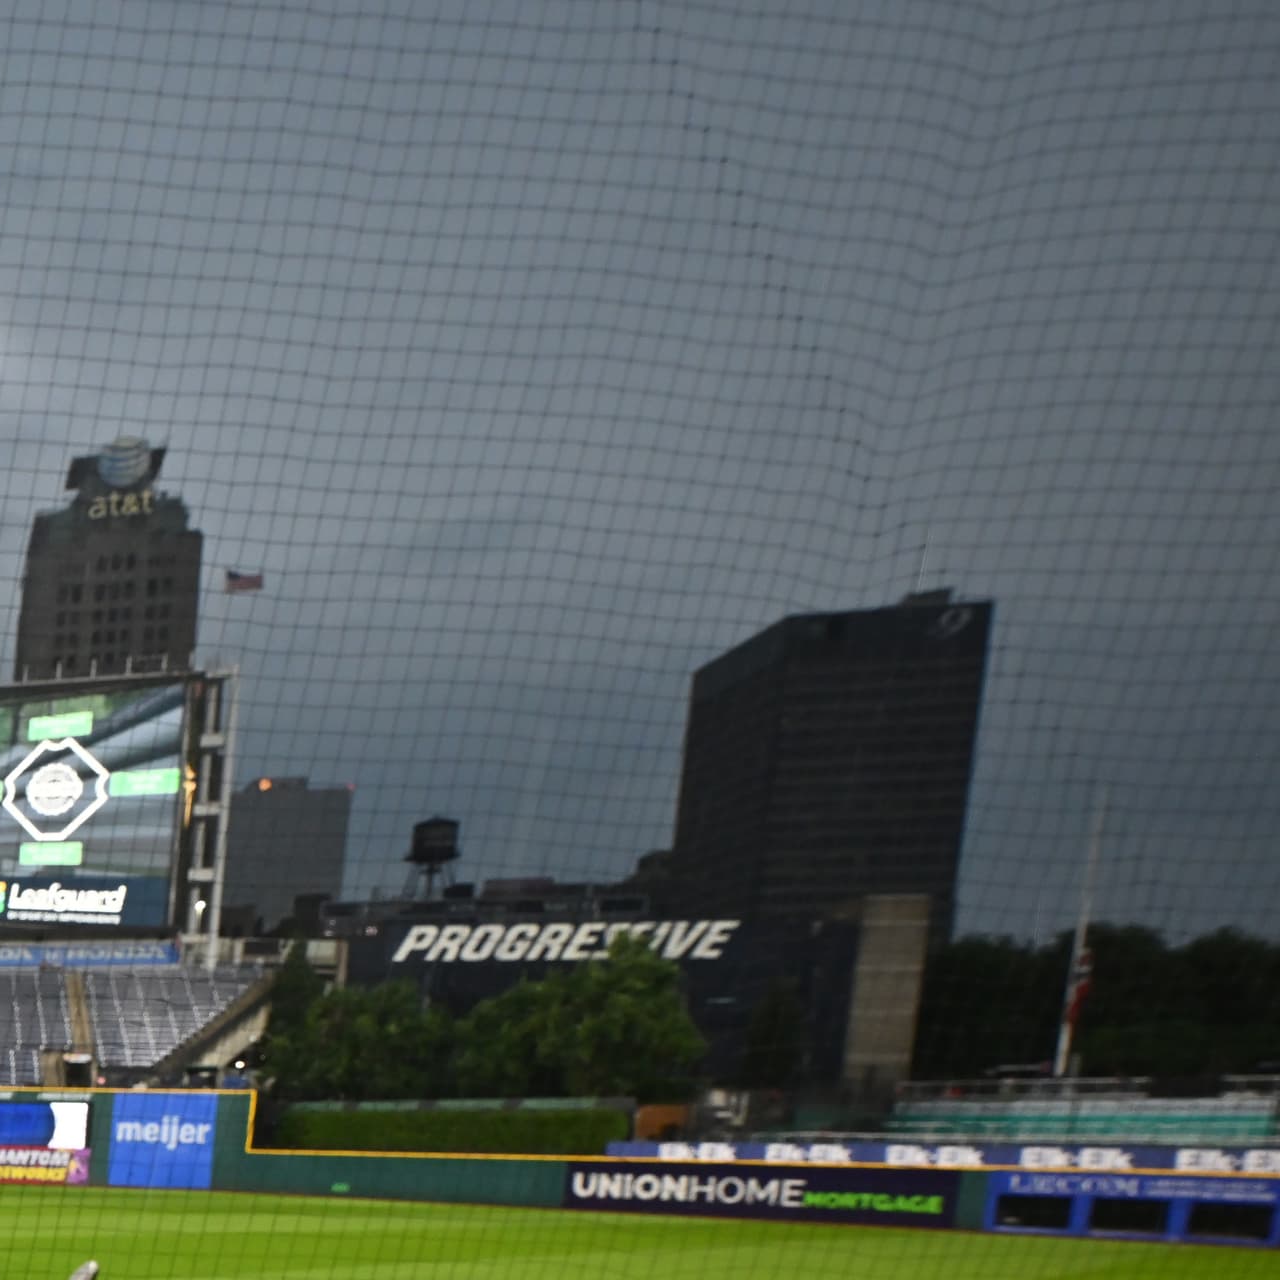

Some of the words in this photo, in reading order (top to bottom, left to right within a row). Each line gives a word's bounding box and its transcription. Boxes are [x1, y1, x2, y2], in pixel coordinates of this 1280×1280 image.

[88, 489, 154, 520] at&t
[116, 1115, 211, 1149] meijer
[803, 1190, 944, 1214] MORTGAGE
